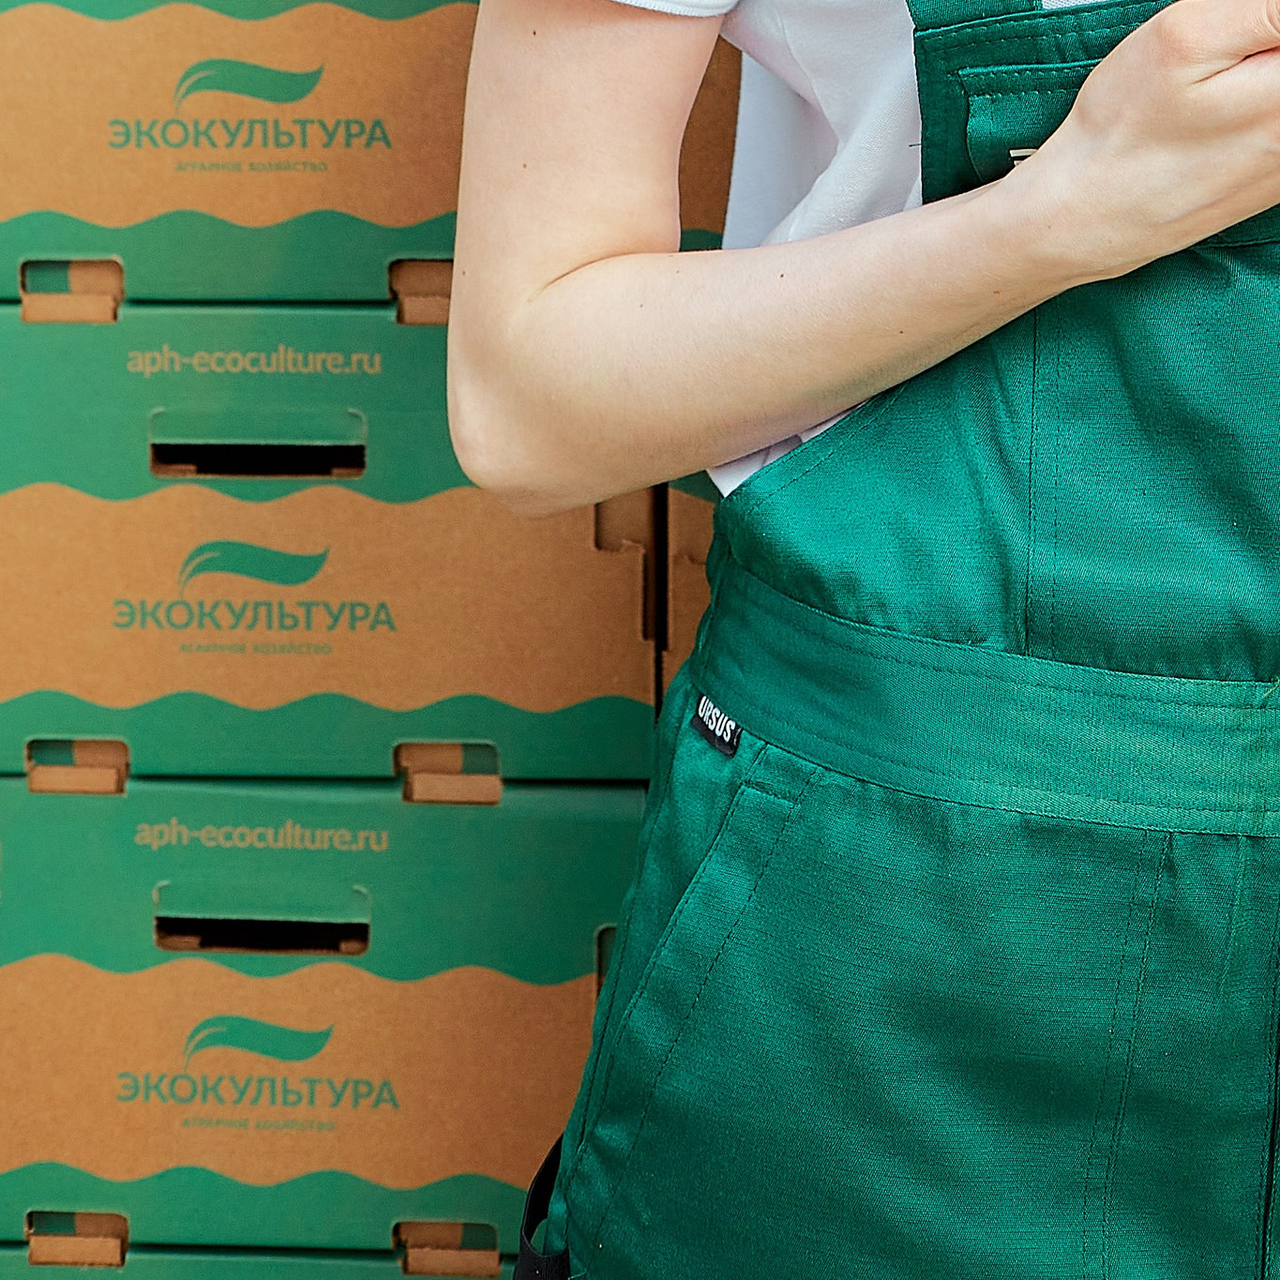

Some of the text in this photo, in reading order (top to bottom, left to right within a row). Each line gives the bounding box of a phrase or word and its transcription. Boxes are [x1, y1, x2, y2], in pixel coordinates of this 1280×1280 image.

[108, 119, 392, 149] ЭКОКУЛЬТУРА
[128, 345, 381, 377] aph-ecoculture.ru
[113, 599, 396, 632] ЭКОКУЛЬТУРА
[698, 695, 736, 743] URSUS
[135, 818, 388, 851] aph-ecoculture.ru
[116, 1072, 400, 1109] ЭКОКУЛЬТУРА
